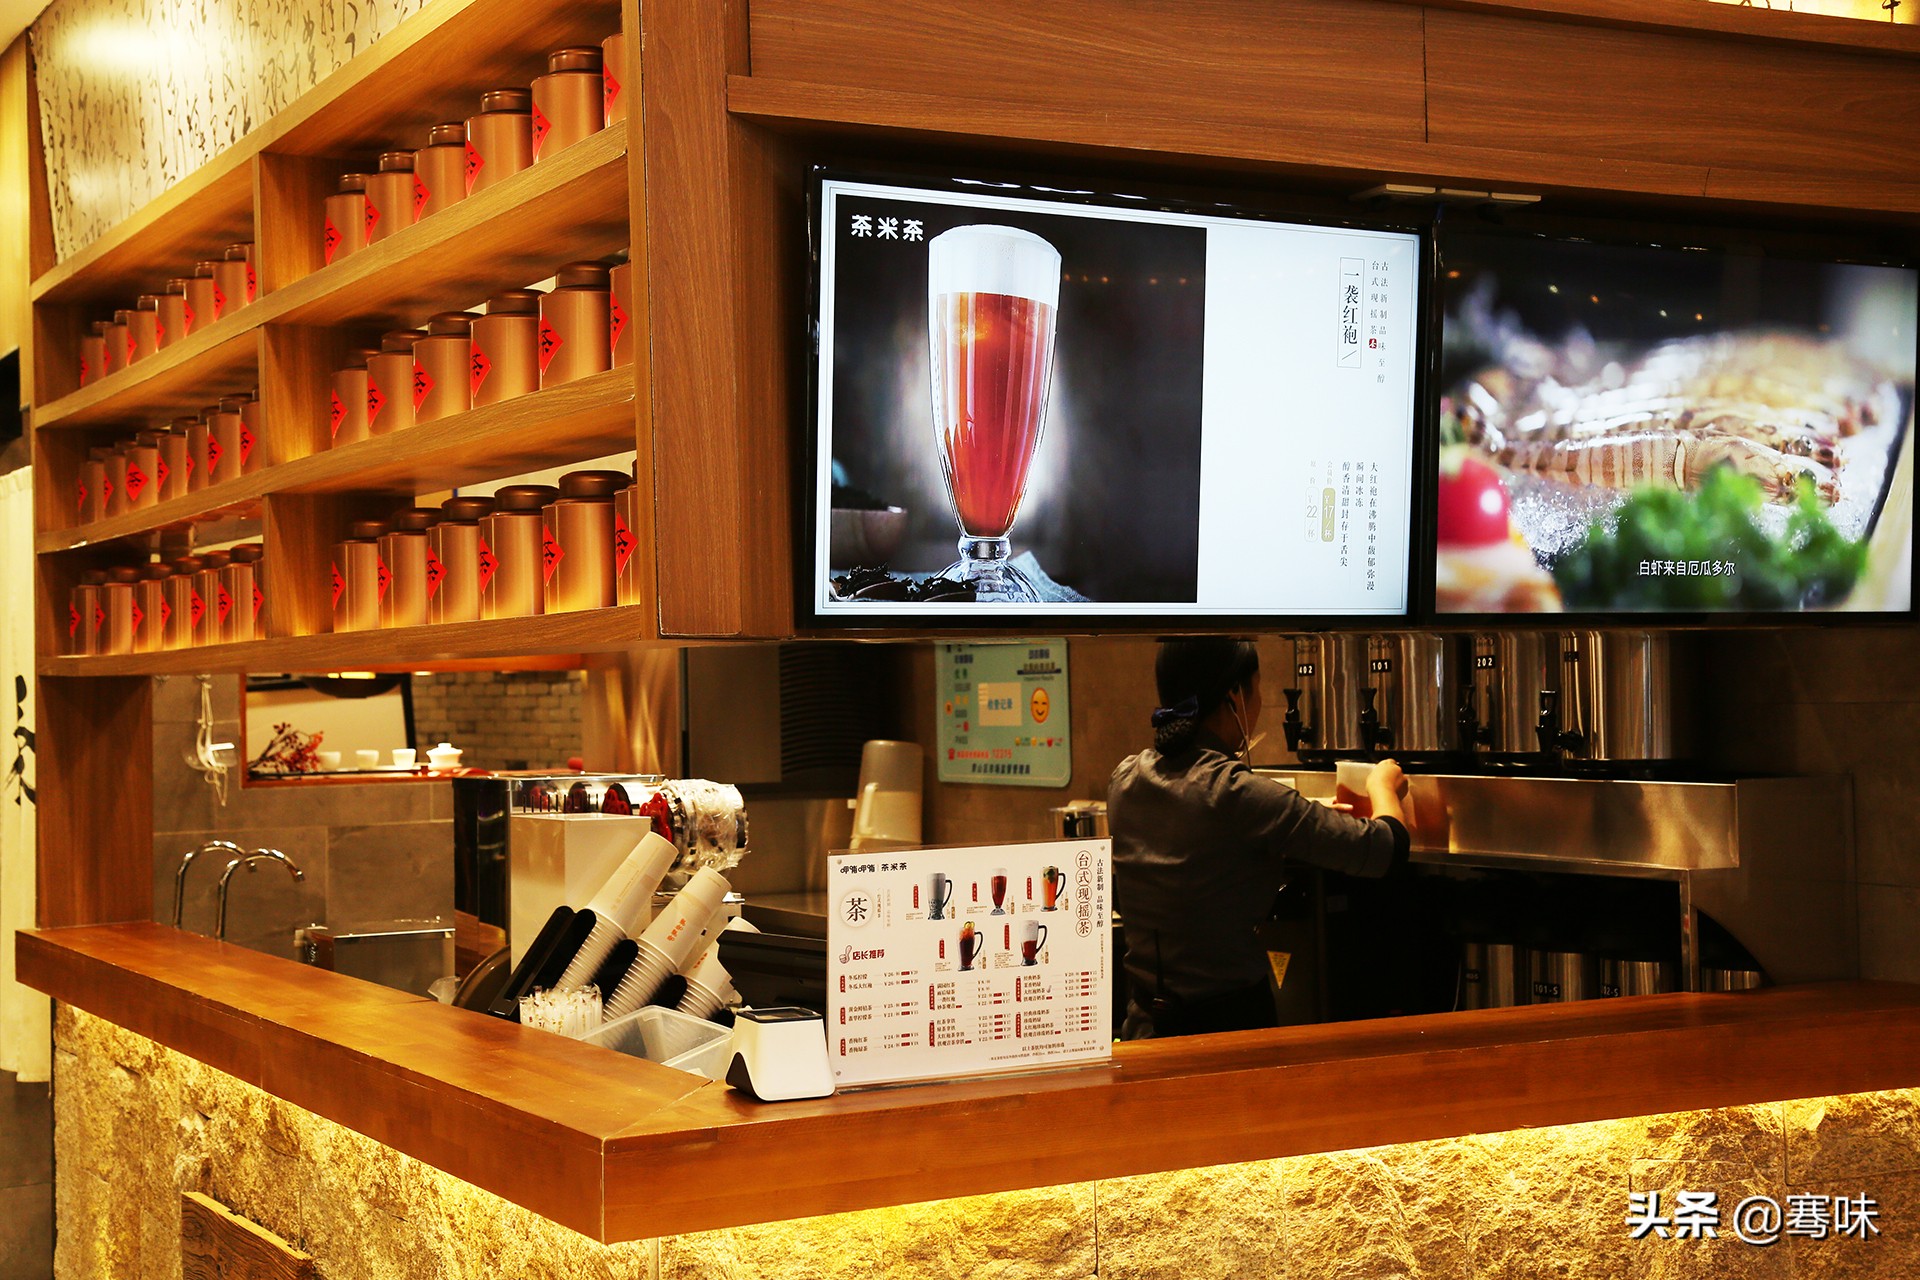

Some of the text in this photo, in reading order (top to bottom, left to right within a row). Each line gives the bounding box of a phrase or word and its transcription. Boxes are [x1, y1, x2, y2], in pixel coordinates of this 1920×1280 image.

[851, 214, 924, 242] 茶米茶
[1342, 272, 1360, 345] 一袭红袍
[1639, 560, 1735, 576] 白虾来自厄瓜多尔
[1372, 661, 1388, 671] 101
[1477, 657, 1493, 667] 202
[881, 862, 907, 872] 茶米茶
[1078, 853, 1090, 934] 台式现摇茶
[846, 897, 868, 922] 茶
[852, 949, 885, 961] 店长推荐
